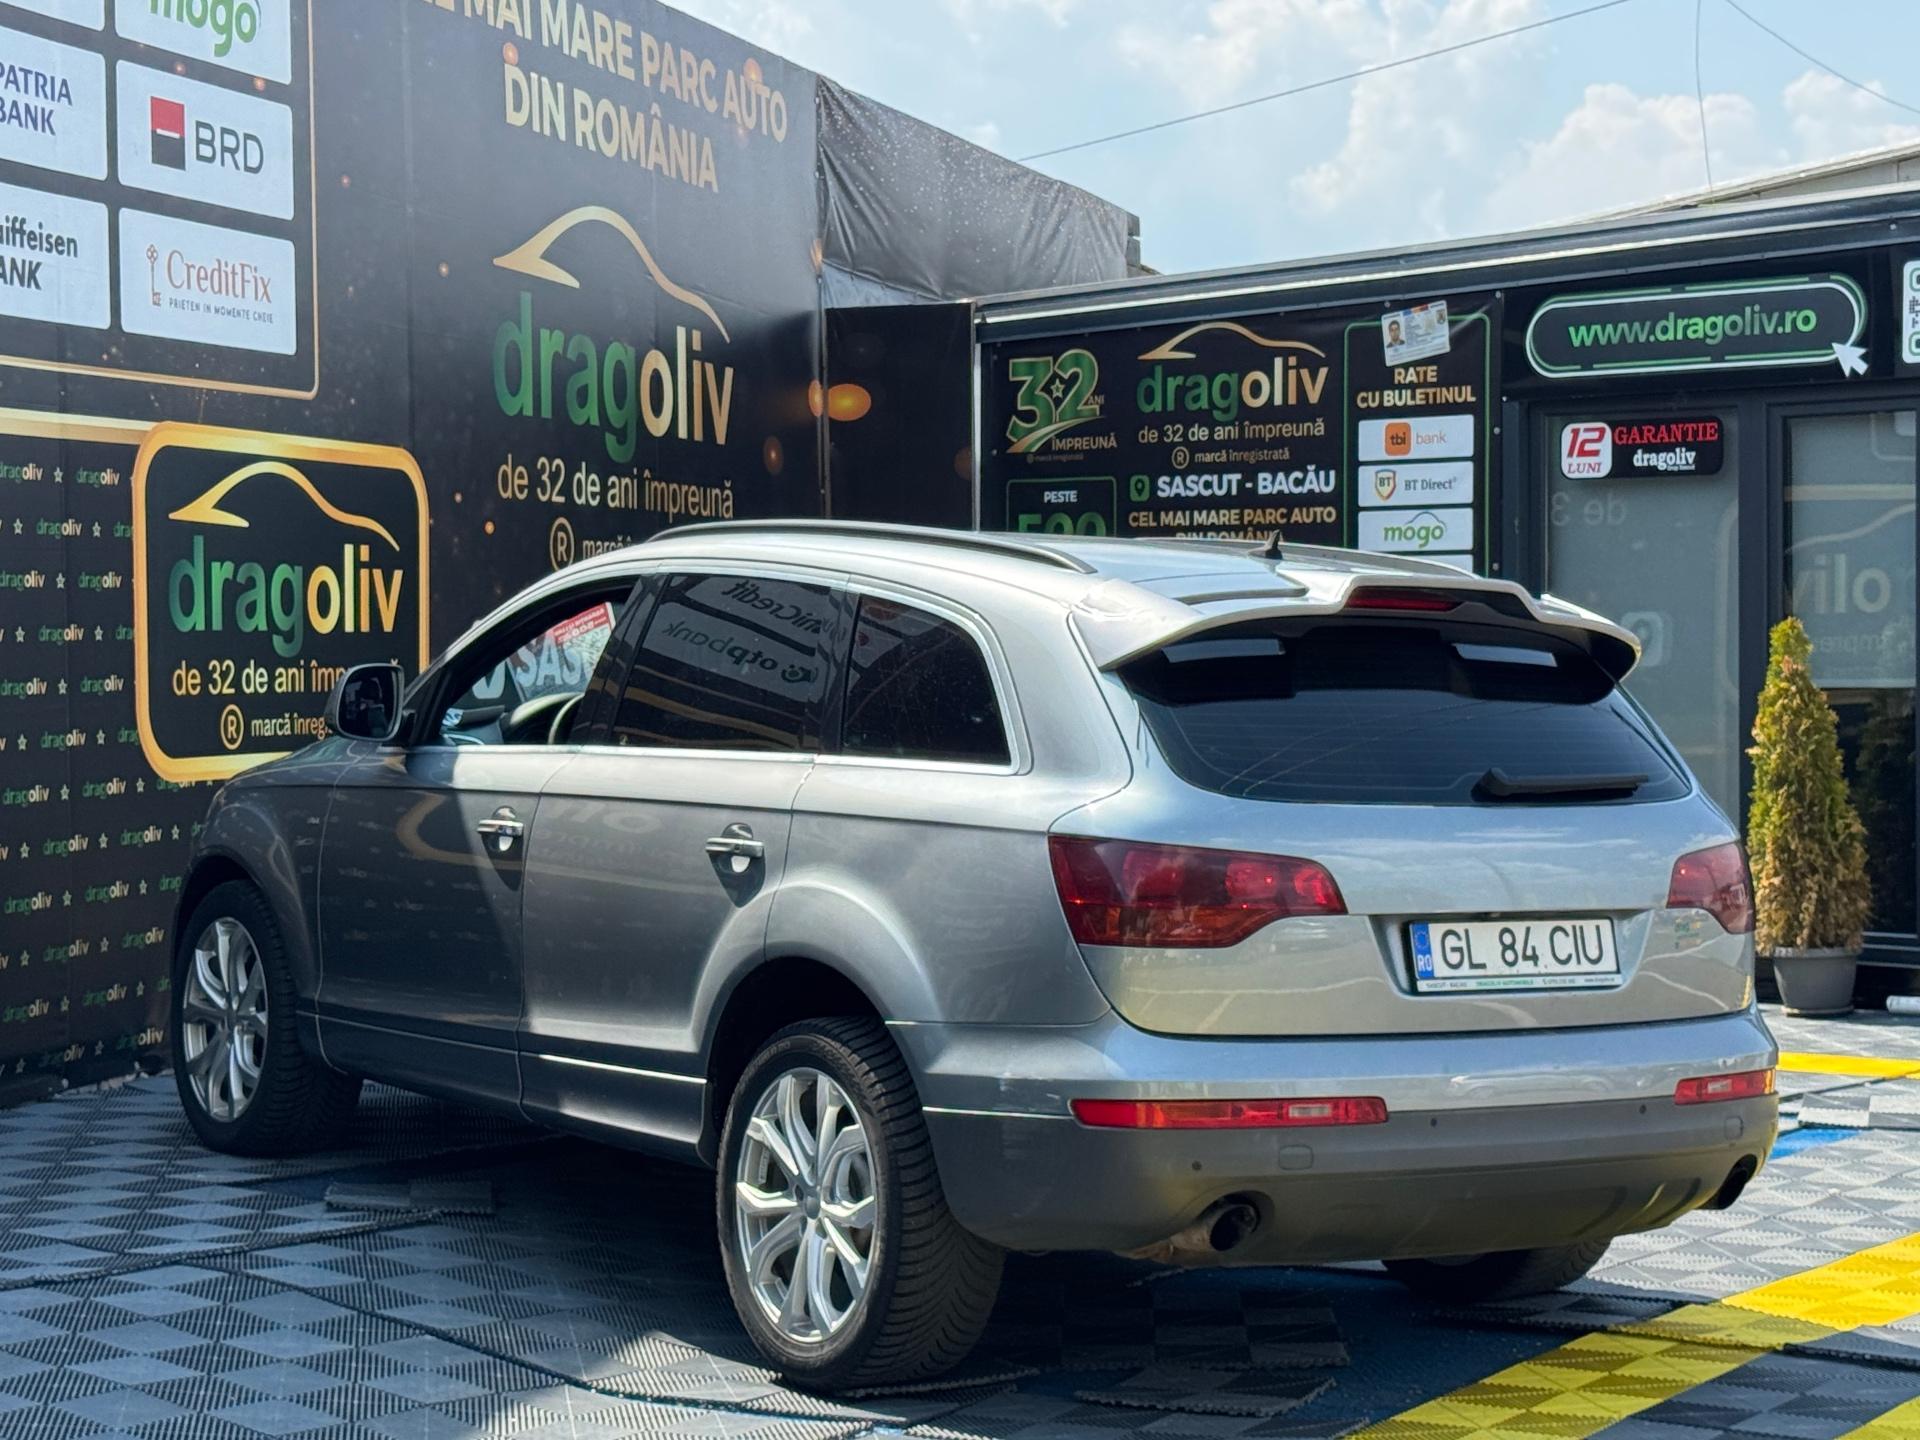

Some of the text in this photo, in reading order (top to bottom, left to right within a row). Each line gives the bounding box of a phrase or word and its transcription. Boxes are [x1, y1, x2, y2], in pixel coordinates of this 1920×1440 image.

[540, 0, 635, 81] MARE
[641, 31, 718, 113] PARC
[723, 69, 788, 143] AUTO
[504, 63, 719, 193] DIN ROMÂNIA
[195, 120, 264, 174] BRD
[167, 250, 272, 303] CreditFix
[1568, 303, 1817, 347] www.dragoliv.ro
[493, 290, 734, 464] dragoliv
[1394, 365, 1438, 384] RATE
[1006, 348, 1099, 442] 32
[1087, 394, 1105, 405] ANI
[1136, 355, 1329, 422] dragoliv
[1356, 385, 1477, 408] CU BULETINUL
[1051, 432, 1118, 451] ÎMPREUNĂ
[1138, 417, 1325, 443] de 32 de ani împreună
[1390, 430, 1447, 446] tbi bank
[1567, 422, 1719, 458] 12 GARANTIE
[1194, 447, 1228, 463] marcă
[1229, 447, 1291, 465] înregistrată
[1567, 462, 1603, 474] LUNI
[1632, 446, 1696, 471] dragoliv
[76, 467, 120, 488] dragoliv
[497, 453, 734, 523] de 32 de ani împreună
[1156, 473, 1242, 499] SASCUT
[1257, 464, 1336, 496] BACĂU
[1378, 477, 1393, 488] BT
[1404, 479, 1418, 491] BT
[1043, 490, 1078, 503] PESTE
[36, 517, 82, 539] dragoliv
[1128, 505, 1337, 528] CEL MAI MARE PARC AUTO
[1383, 525, 1445, 549] mogo
[78, 571, 122, 592] dragoliv
[168, 535, 404, 658] dragoliv
[38, 624, 84, 645] dragoliv
[0, 674, 124, 699] dragoliv dragoliv
[173, 660, 201, 696] de
[208, 659, 236, 695] 32
[242, 659, 268, 694] de
[274, 660, 305, 693] ani
[251, 713, 292, 737] marcă
[40, 729, 86, 751] dragoliv
[3, 785, 50, 807] dragoliv
[82, 777, 126, 799] dragoliv
[43, 825, 163, 857] dragoliv dragoliv
[4, 891, 53, 915] dragoliv
[85, 880, 129, 903] dragoliv
[1441, 924, 1604, 970] GL 84 CIU
[1417, 954, 1433, 972] RO
